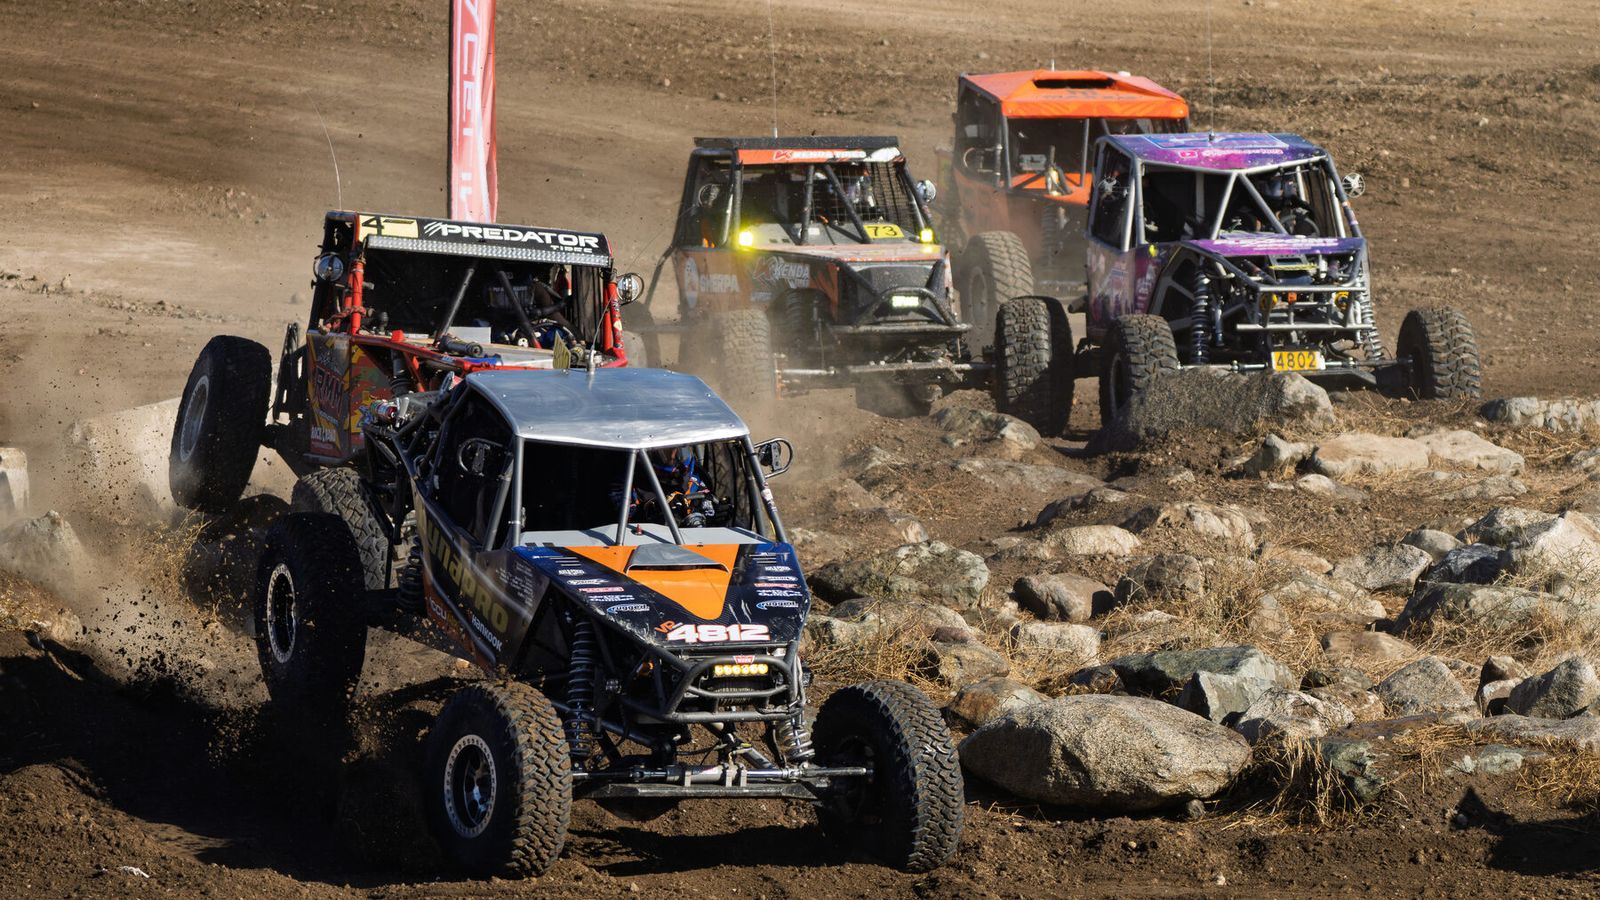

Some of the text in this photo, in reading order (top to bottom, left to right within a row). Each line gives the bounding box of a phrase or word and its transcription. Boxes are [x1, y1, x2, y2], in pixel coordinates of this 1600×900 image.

[441, 223, 599, 248] PREDATOR
[866, 225, 897, 237] 73
[774, 262, 810, 281] KENDA
[1276, 351, 1317, 369] 4802
[426, 519, 509, 634] ynaPRO
[667, 623, 771, 643] 4812
